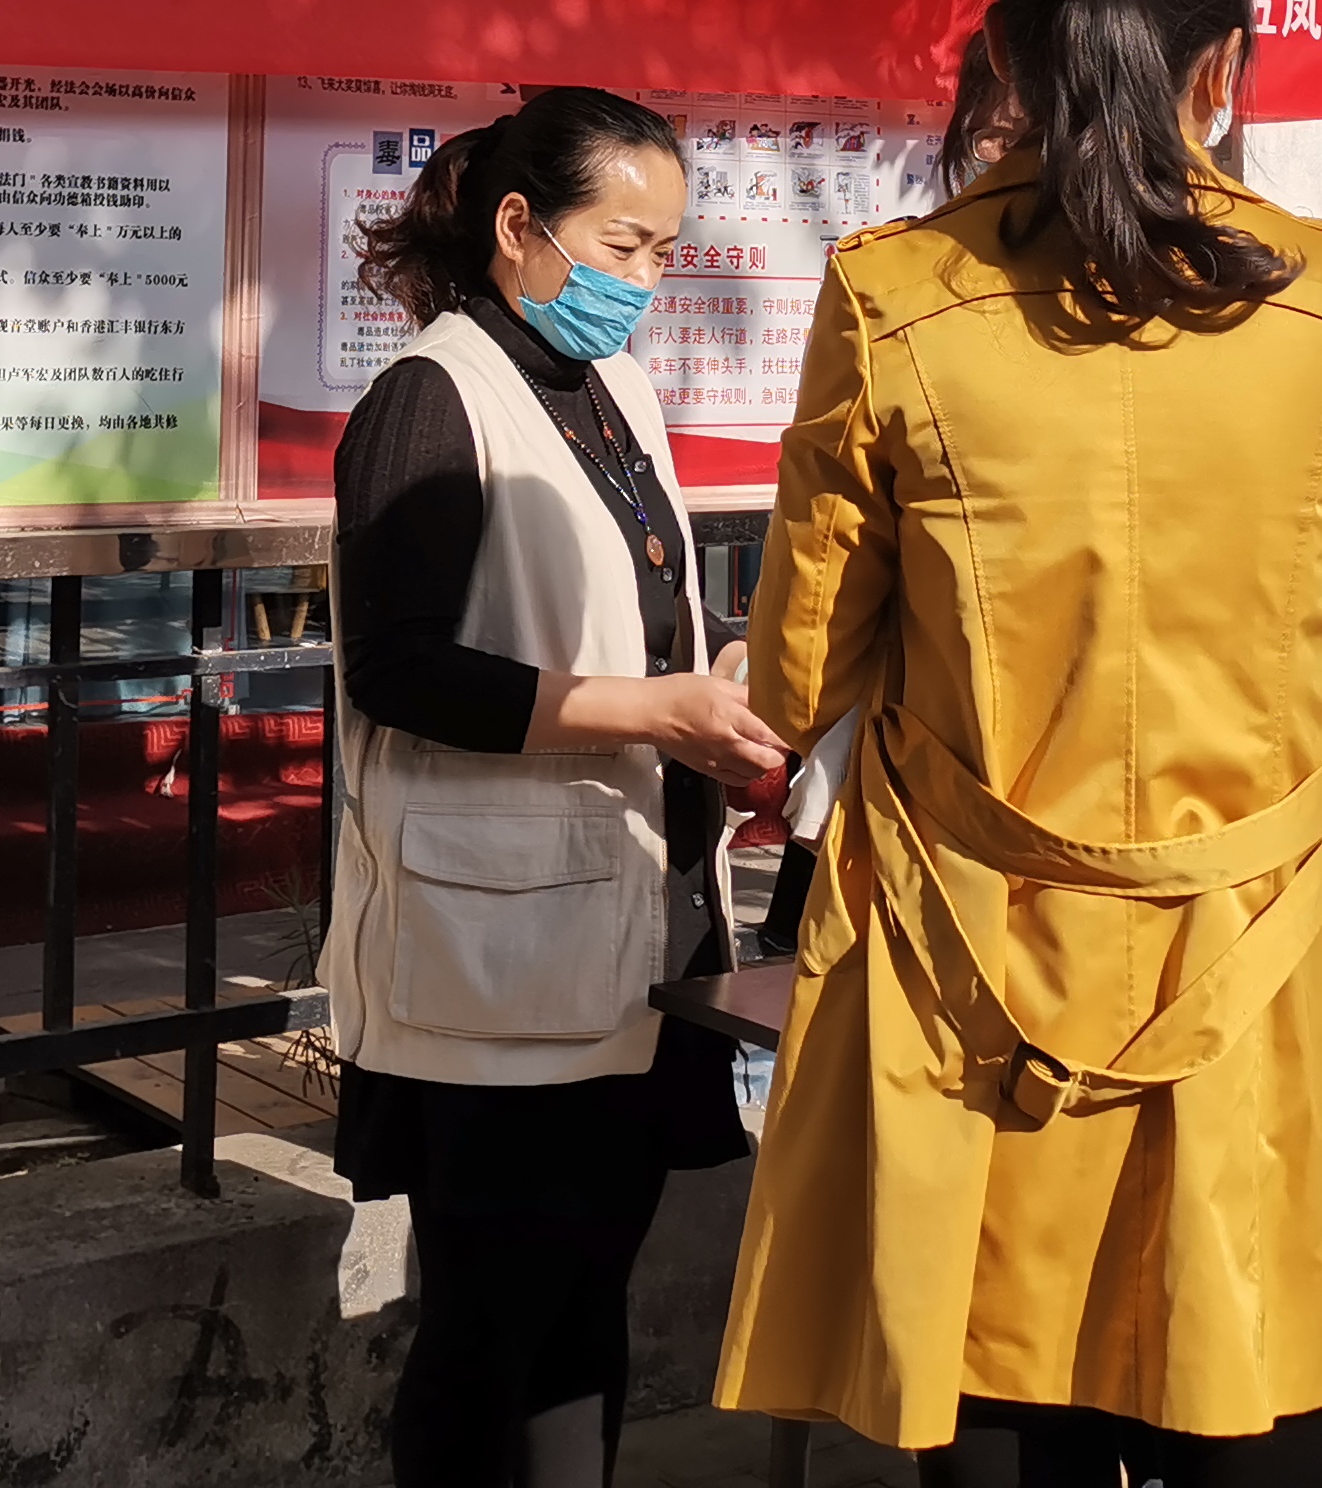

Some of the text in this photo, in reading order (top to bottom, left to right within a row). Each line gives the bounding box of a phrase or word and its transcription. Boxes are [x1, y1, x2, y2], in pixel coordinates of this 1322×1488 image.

[650, 296, 815, 316] 交通安全很重要，守则规定
